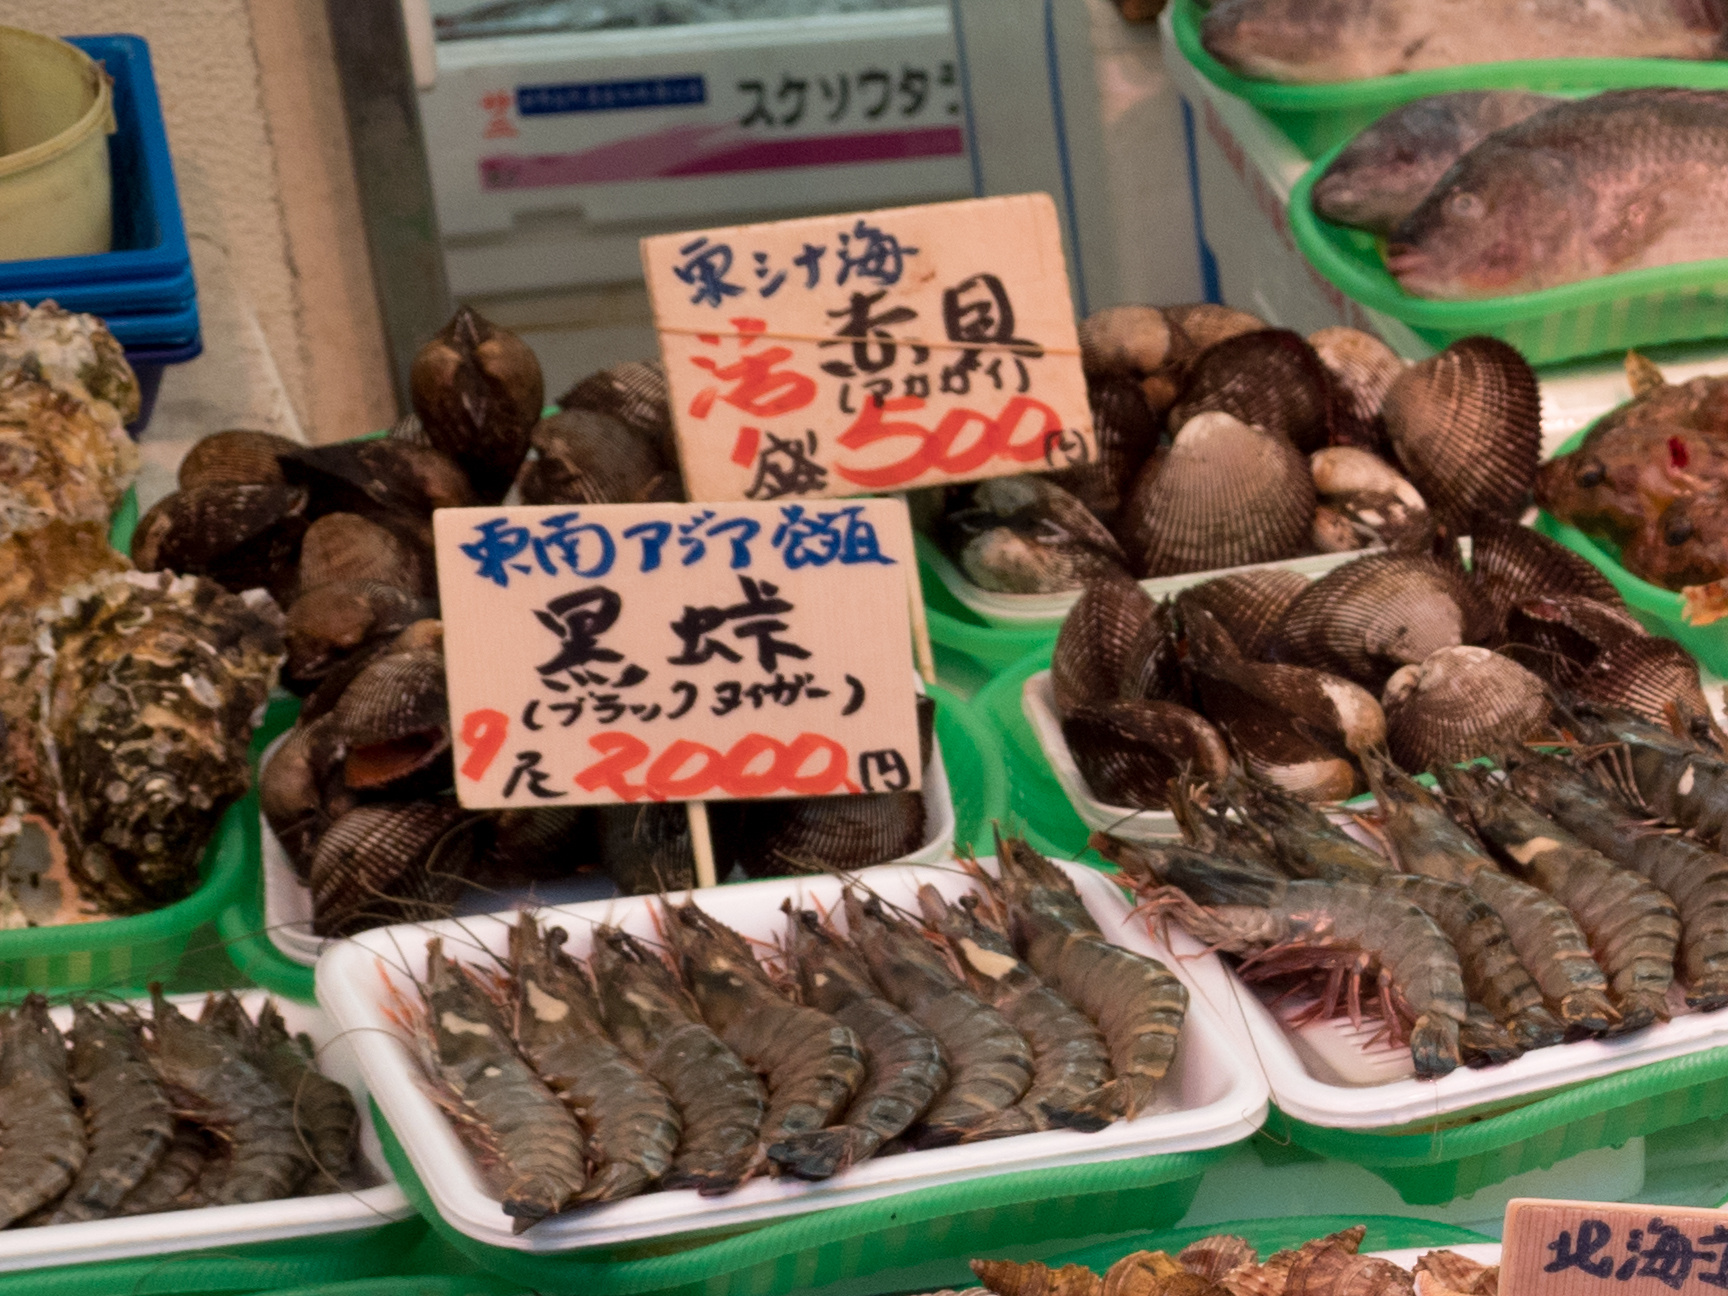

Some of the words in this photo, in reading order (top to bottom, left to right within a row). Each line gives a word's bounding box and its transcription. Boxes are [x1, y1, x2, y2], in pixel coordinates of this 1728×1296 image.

[672, 220, 919, 307] 東シナ海
[689, 317, 817, 418] 活
[817, 272, 1045, 378] 赤貝
